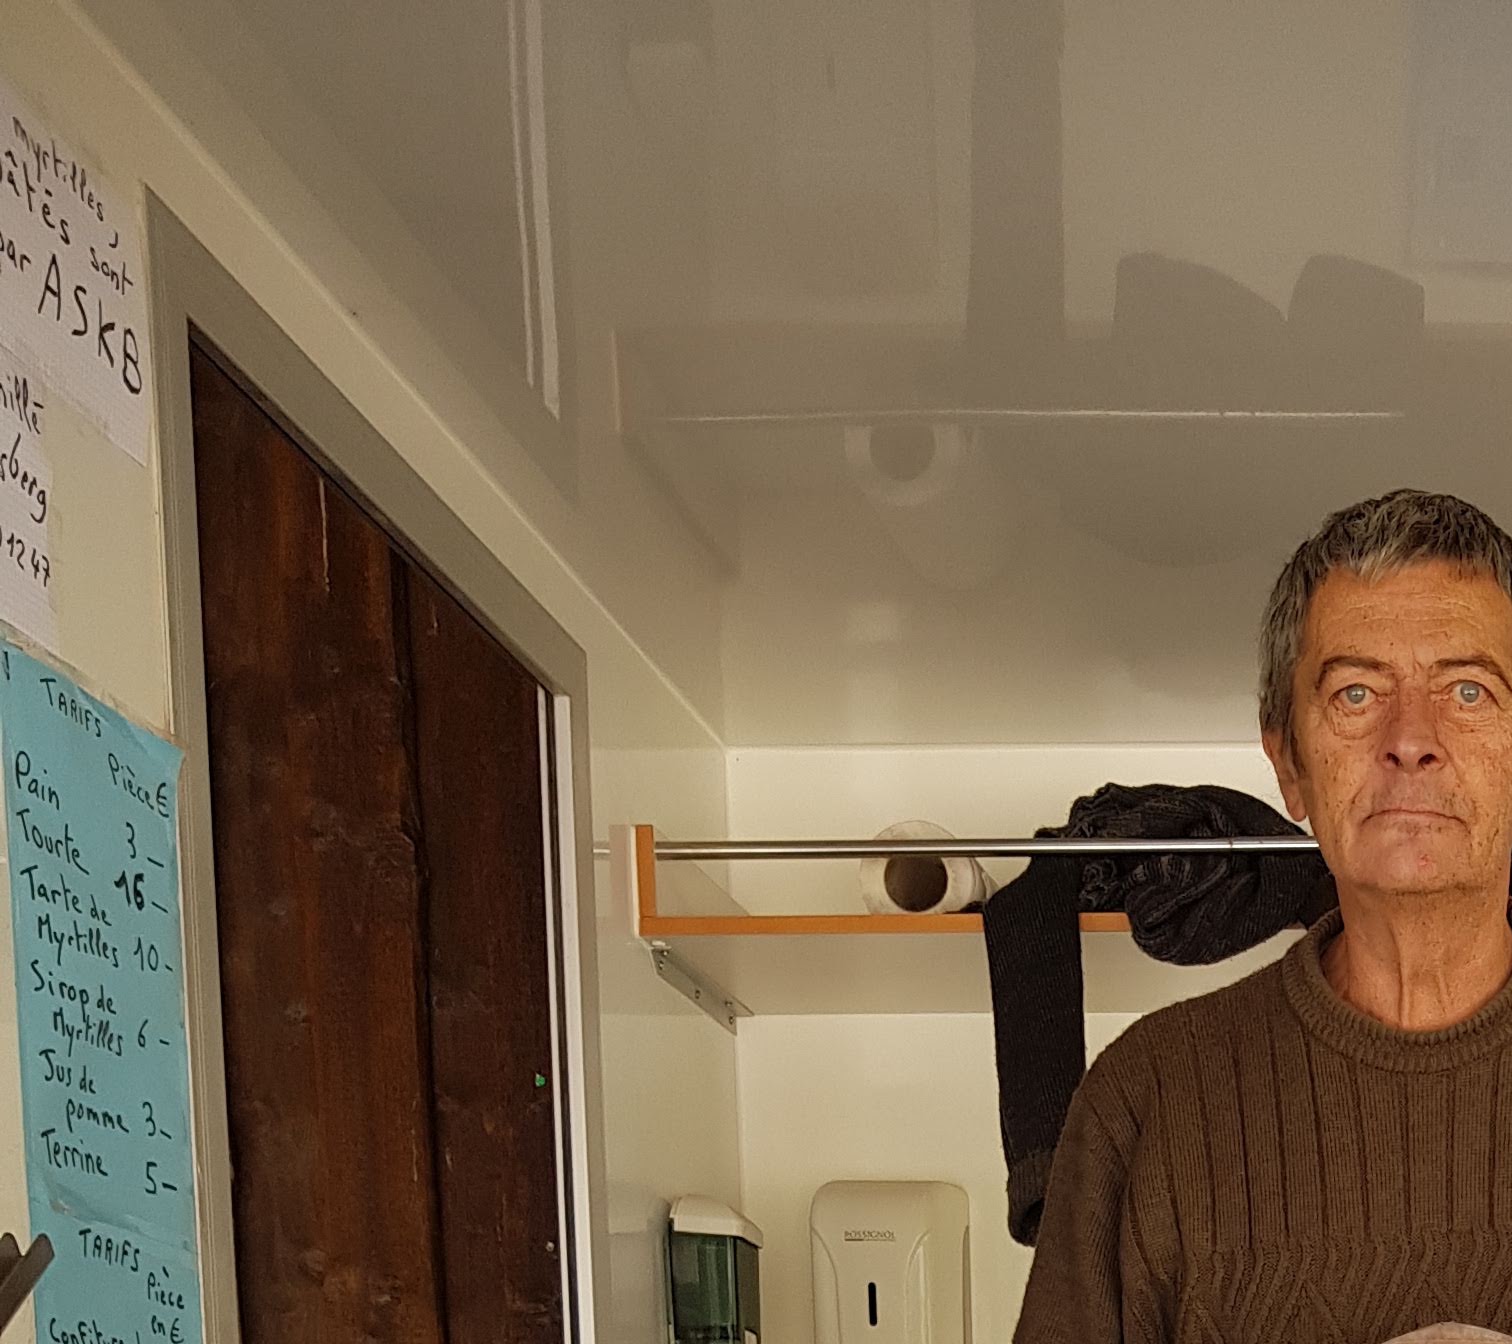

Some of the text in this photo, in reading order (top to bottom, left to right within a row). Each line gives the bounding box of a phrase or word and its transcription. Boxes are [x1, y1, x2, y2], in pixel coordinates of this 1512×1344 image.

[0, 150, 133, 296] âtés sont
[40, 678, 102, 738] TARIFS
[15, 750, 60, 811] Pain
[16, 808, 89, 876] Tourte
[20, 865, 112, 927] Tarte de
[38, 914, 119, 968] Myrtilles
[31, 959, 117, 1024] Sirop de
[53, 1007, 124, 1059] Myrtilles
[38, 1049, 97, 1095] Jus de
[66, 1098, 130, 1135] pomme
[41, 1128, 108, 1179] Terrine
[79, 1227, 141, 1273] TARIFS
[147, 1265, 185, 1310] Pièce
[151, 1314, 184, 1344] en €
